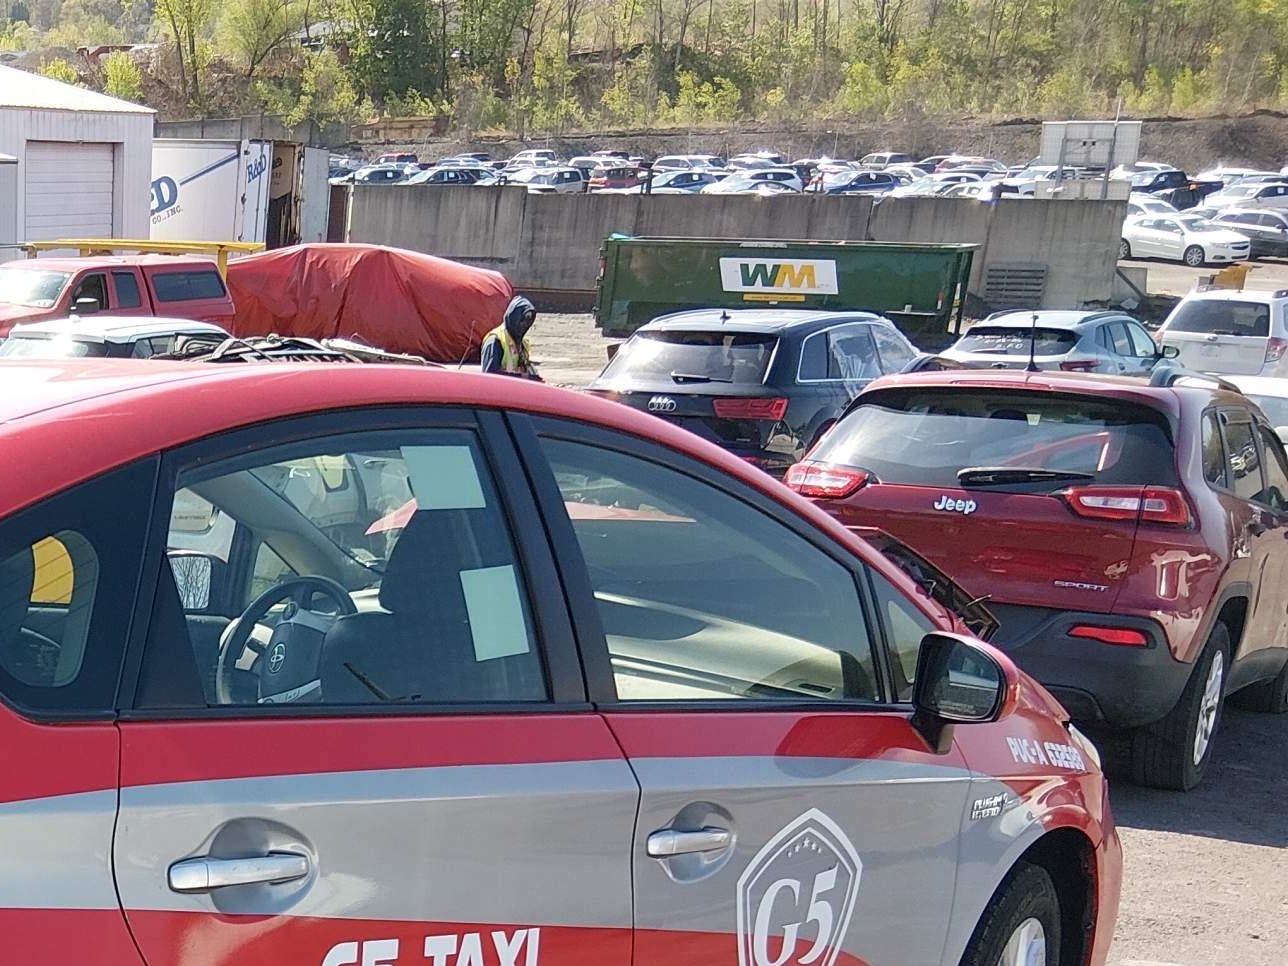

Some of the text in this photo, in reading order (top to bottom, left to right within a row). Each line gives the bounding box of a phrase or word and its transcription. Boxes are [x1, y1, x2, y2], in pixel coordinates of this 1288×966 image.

[247, 154, 267, 183] R&D
[739, 263, 816, 288] WM
[934, 495, 976, 515] Jeep
[1054, 580, 1111, 591] SPORT
